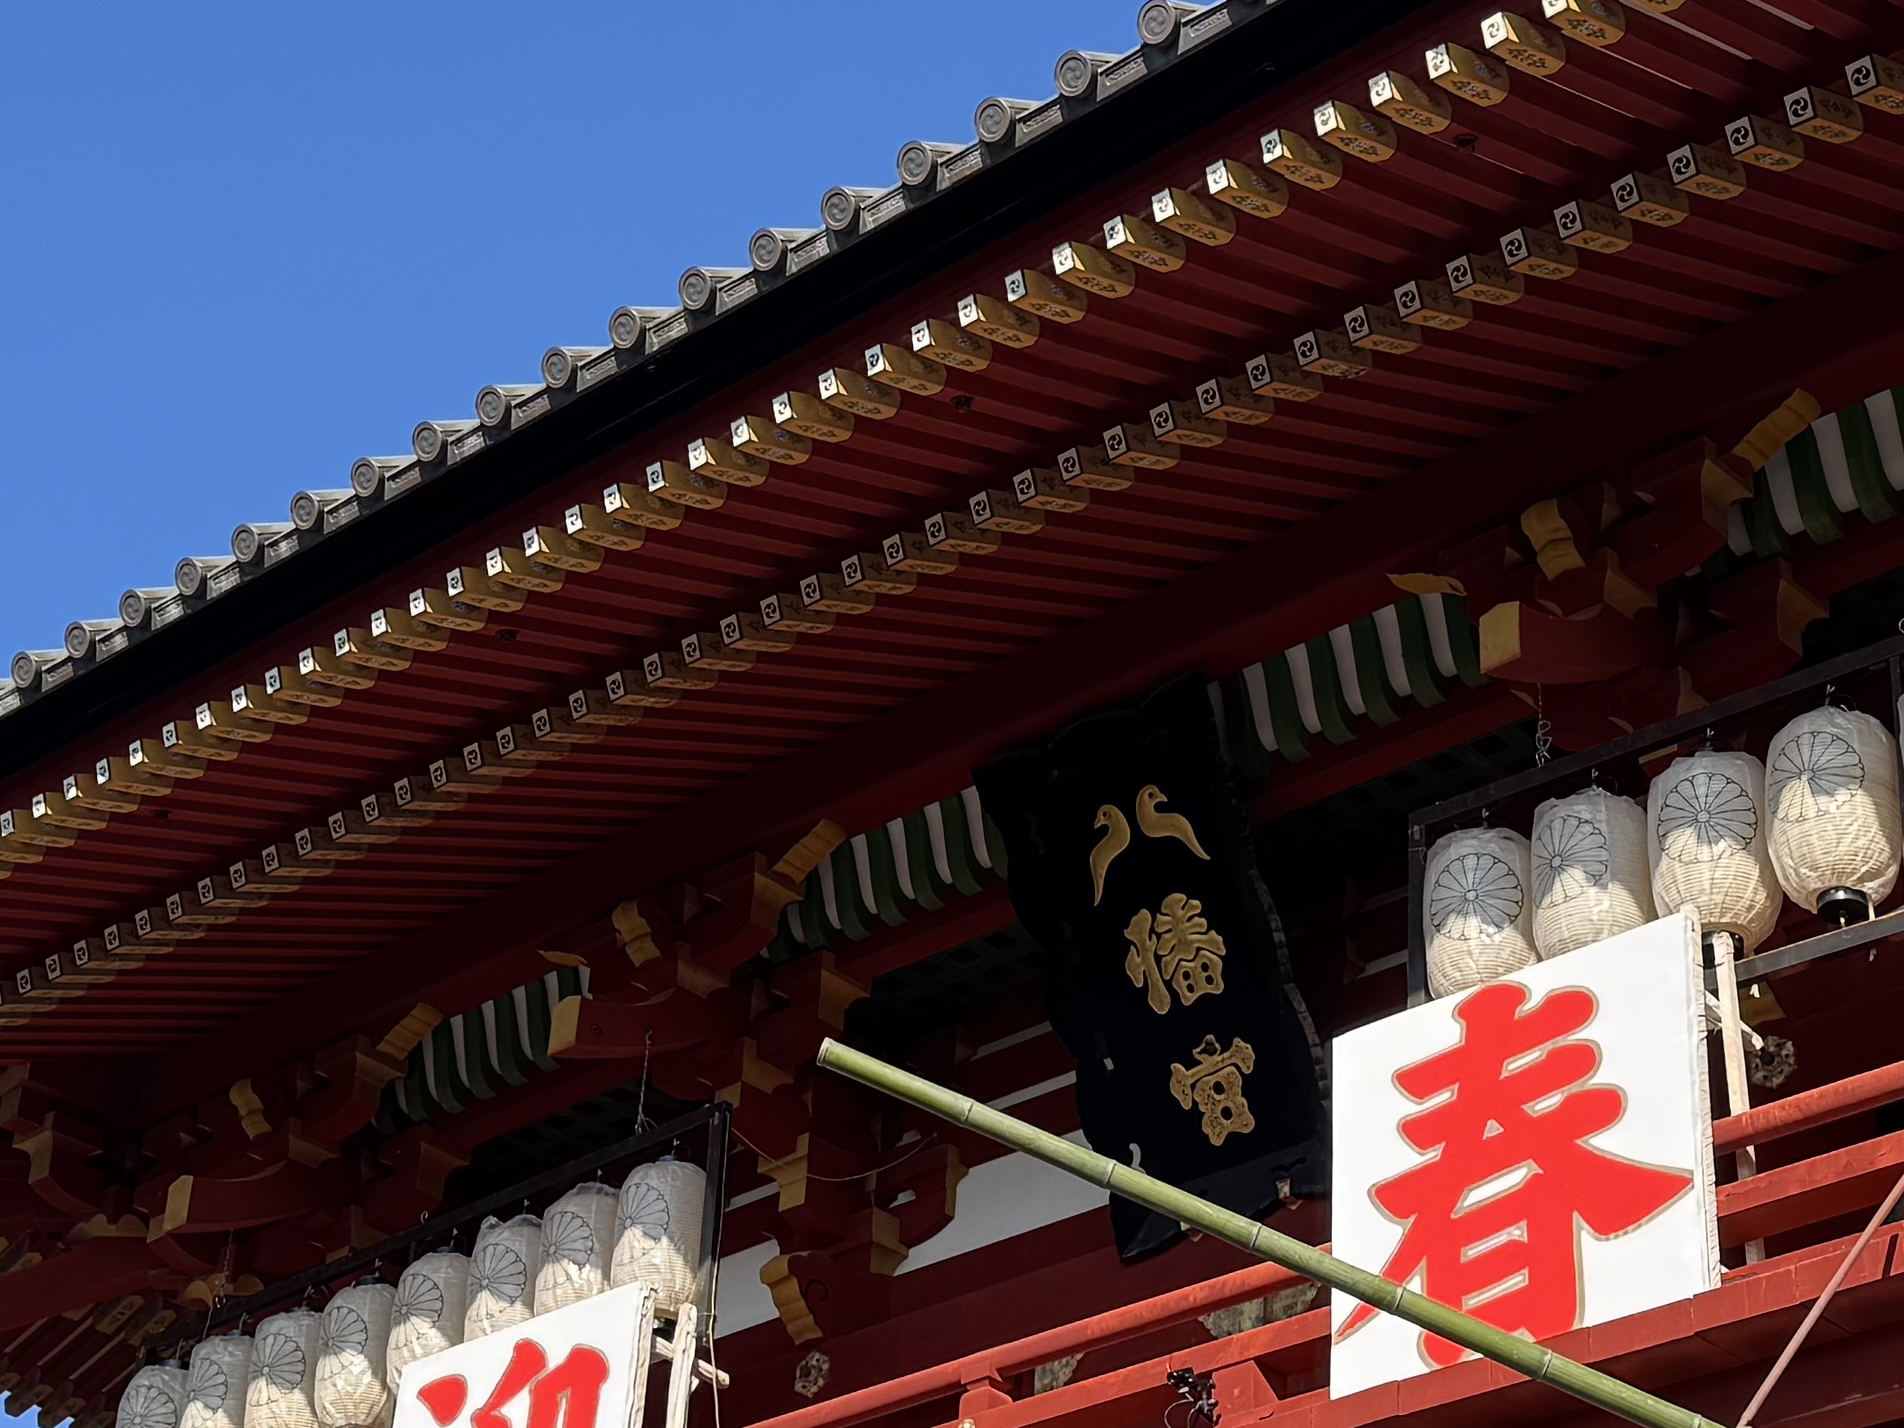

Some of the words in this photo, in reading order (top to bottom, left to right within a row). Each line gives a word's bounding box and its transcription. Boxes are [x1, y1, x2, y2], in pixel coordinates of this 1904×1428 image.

[1088, 783, 1257, 1148] 八幡宮
[1334, 981, 1696, 1370] 春
